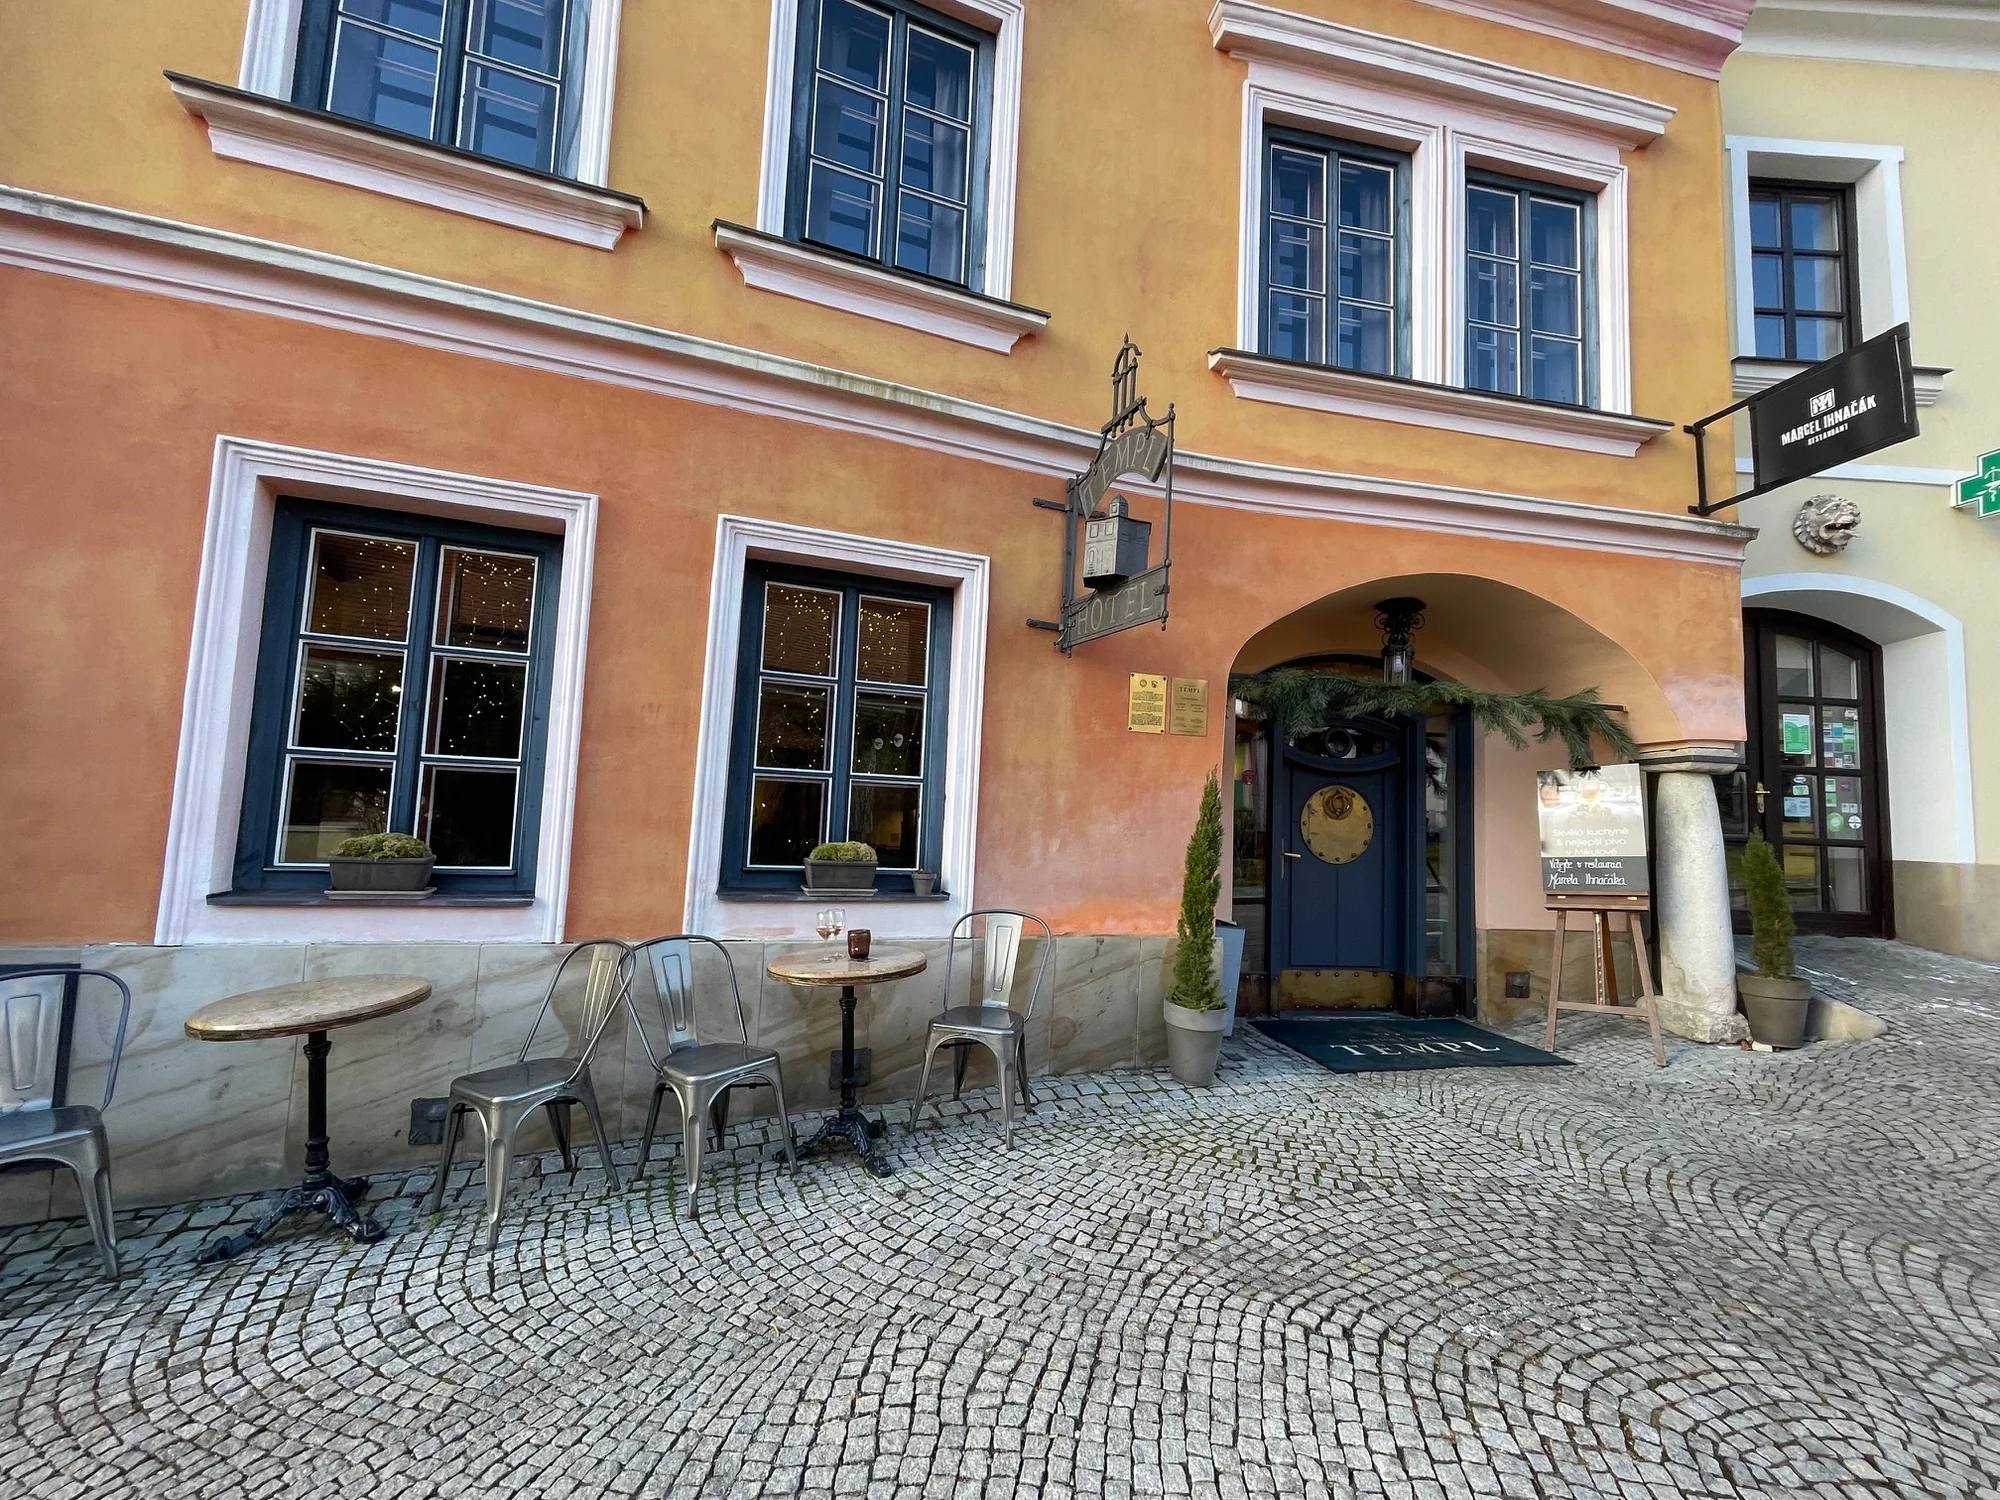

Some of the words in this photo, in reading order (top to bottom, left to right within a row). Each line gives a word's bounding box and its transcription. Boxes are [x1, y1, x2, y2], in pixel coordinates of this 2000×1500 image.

[1781, 420, 1821, 446] MARCEL
[1823, 394, 1877, 429] IHNAČÁK
[1083, 432, 1157, 505] TEMPL
[1077, 580, 1153, 635] HOTEL
[1604, 838, 1627, 846] pivo
[1329, 1042, 1501, 1055] TEMPL
